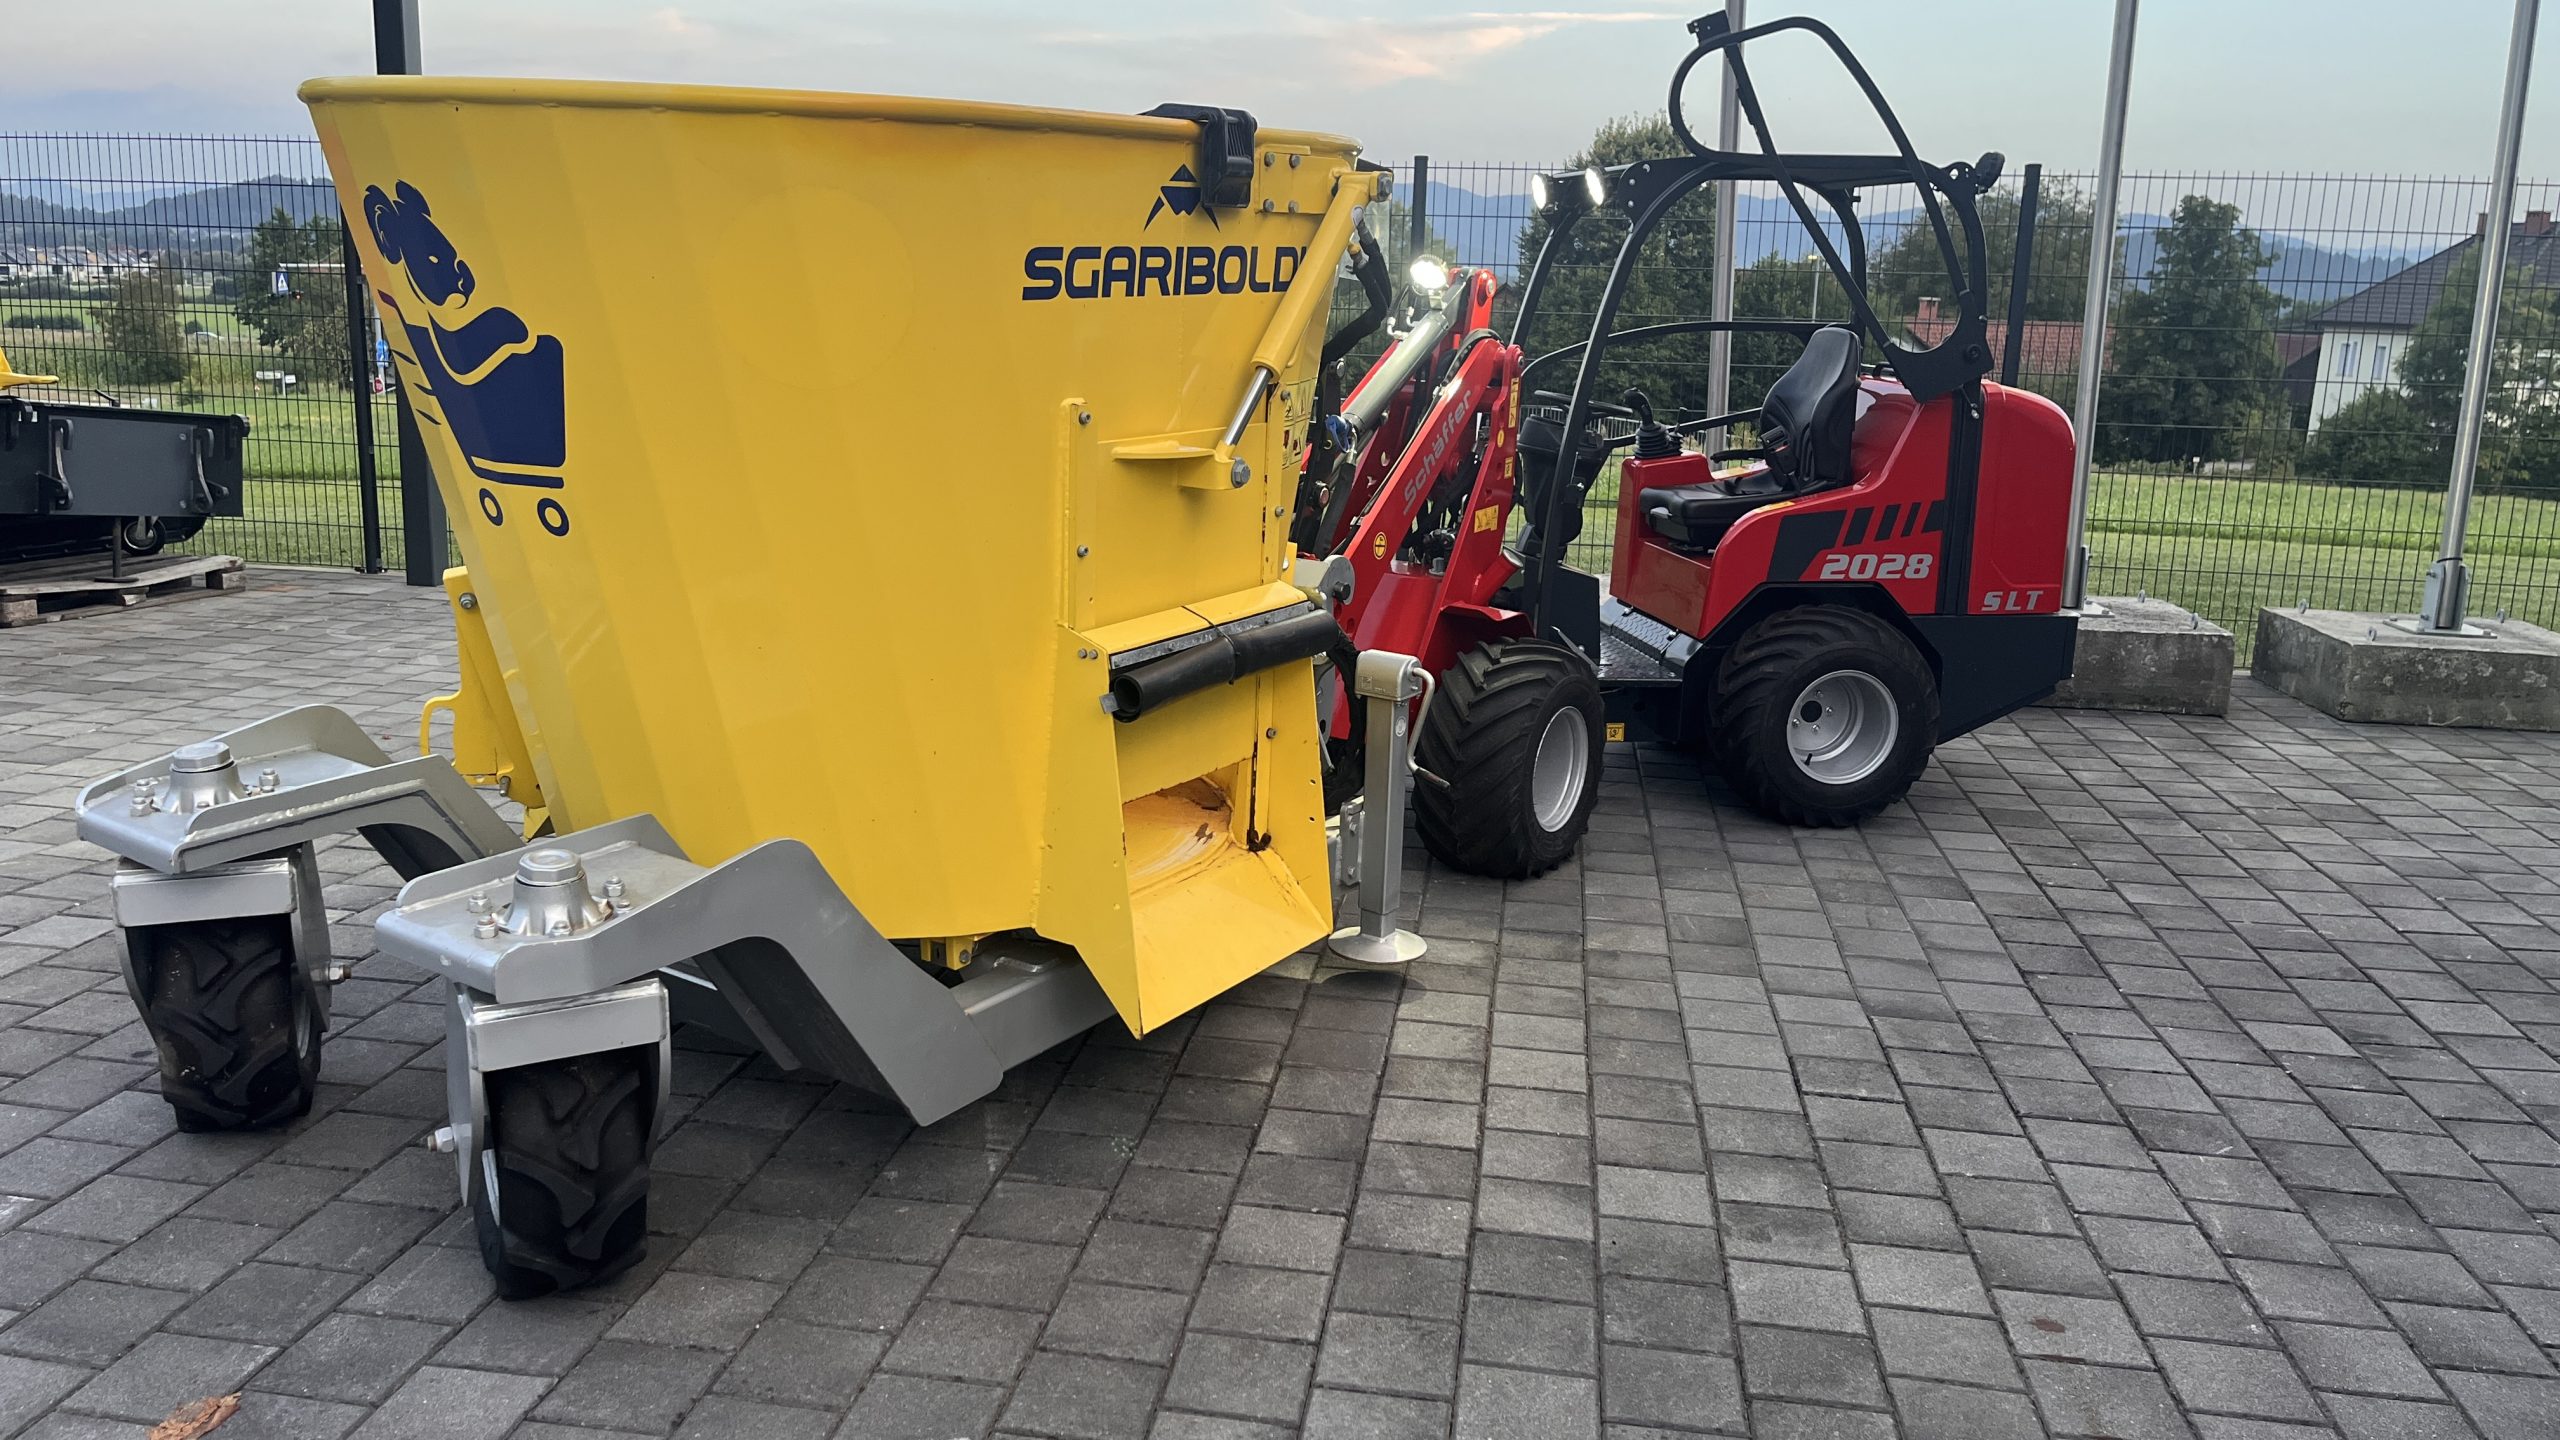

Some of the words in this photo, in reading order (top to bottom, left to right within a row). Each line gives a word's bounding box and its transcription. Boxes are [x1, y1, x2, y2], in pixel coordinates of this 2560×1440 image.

[1022, 246, 1307, 300] SGARIBOLD
[1403, 389, 1472, 516] Schäffer
[1819, 553, 1934, 580] 2028
[1981, 590, 2044, 612] SLT
